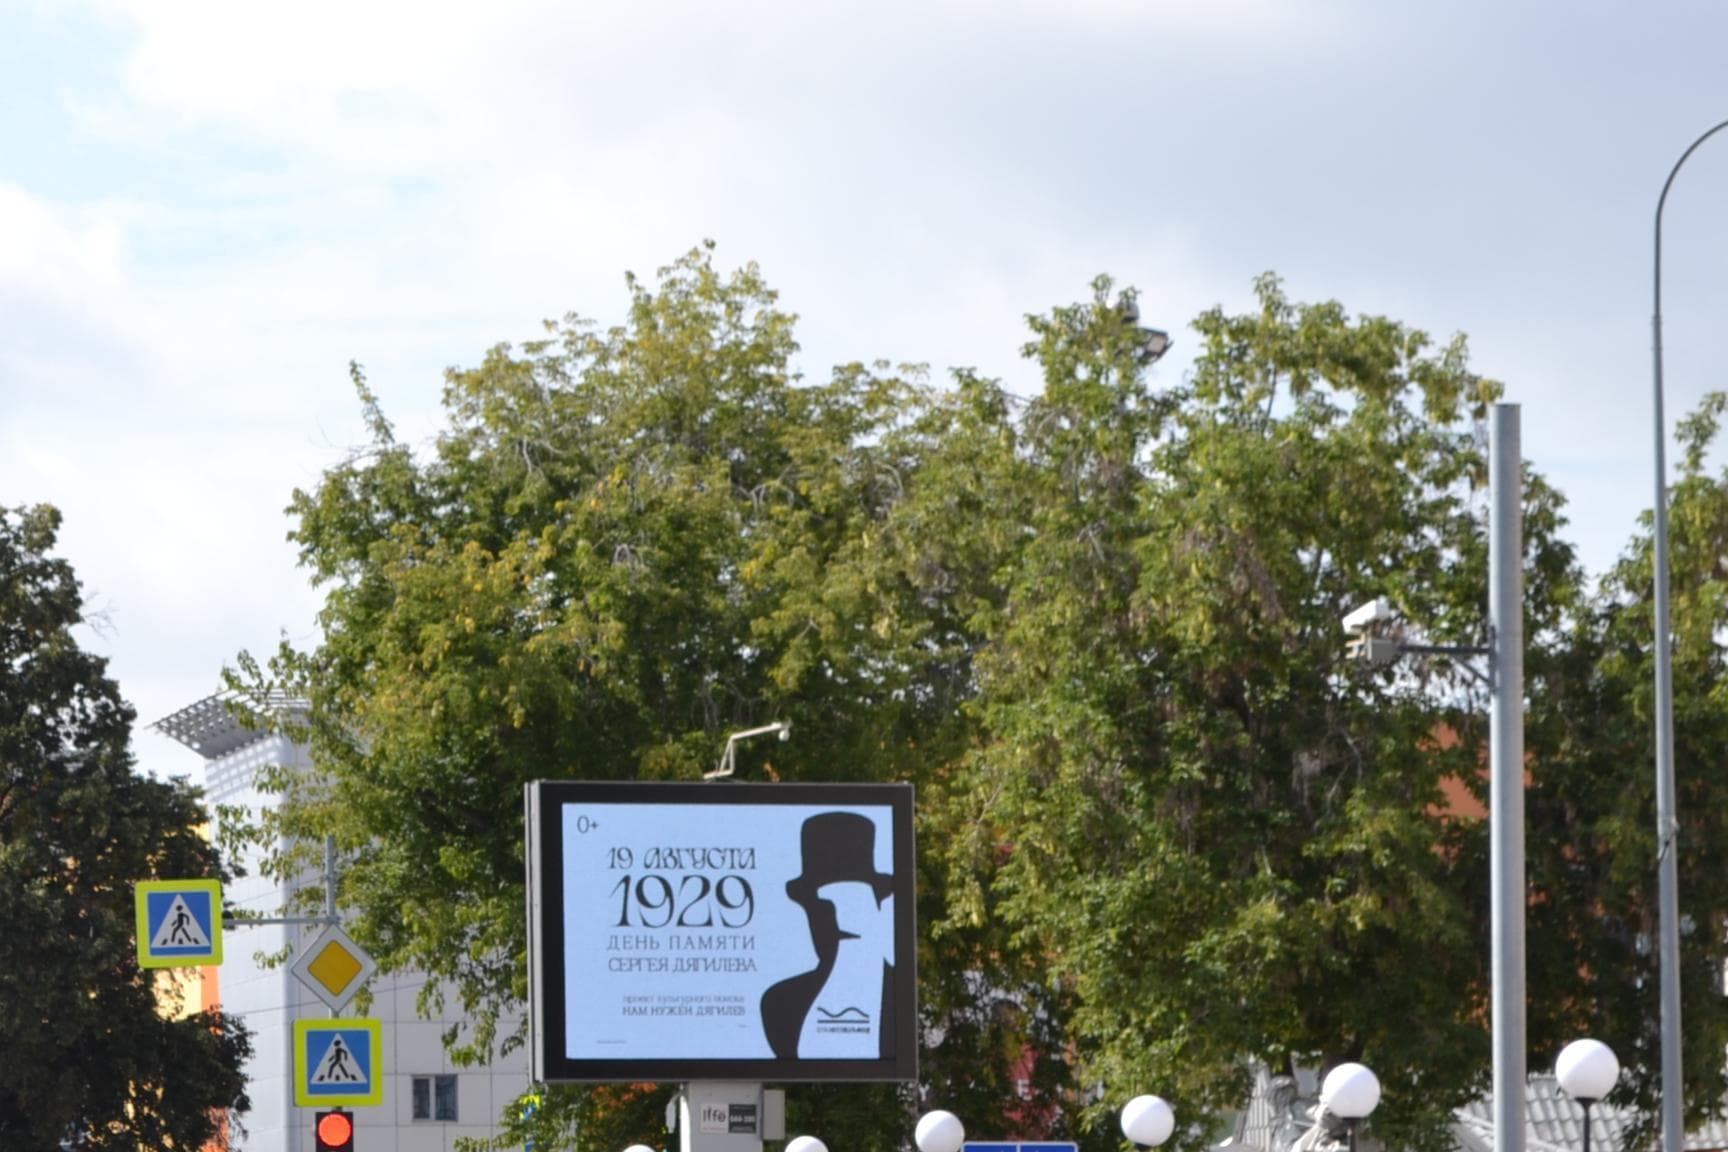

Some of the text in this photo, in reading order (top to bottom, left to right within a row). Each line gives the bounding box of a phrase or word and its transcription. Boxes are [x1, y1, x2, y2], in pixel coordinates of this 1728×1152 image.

[576, 815, 599, 834] 0+
[607, 847, 757, 870] 19 АВГУСТА
[609, 874, 755, 929] 1929
[607, 935, 756, 952] ДЕНЬ ПАМЯТИ
[607, 957, 758, 973] СЕРГЕЯ ДЯГИЛЕВА
[622, 1005, 746, 1018] НАМ НУЖЕН ДЯГИЛЕВ
